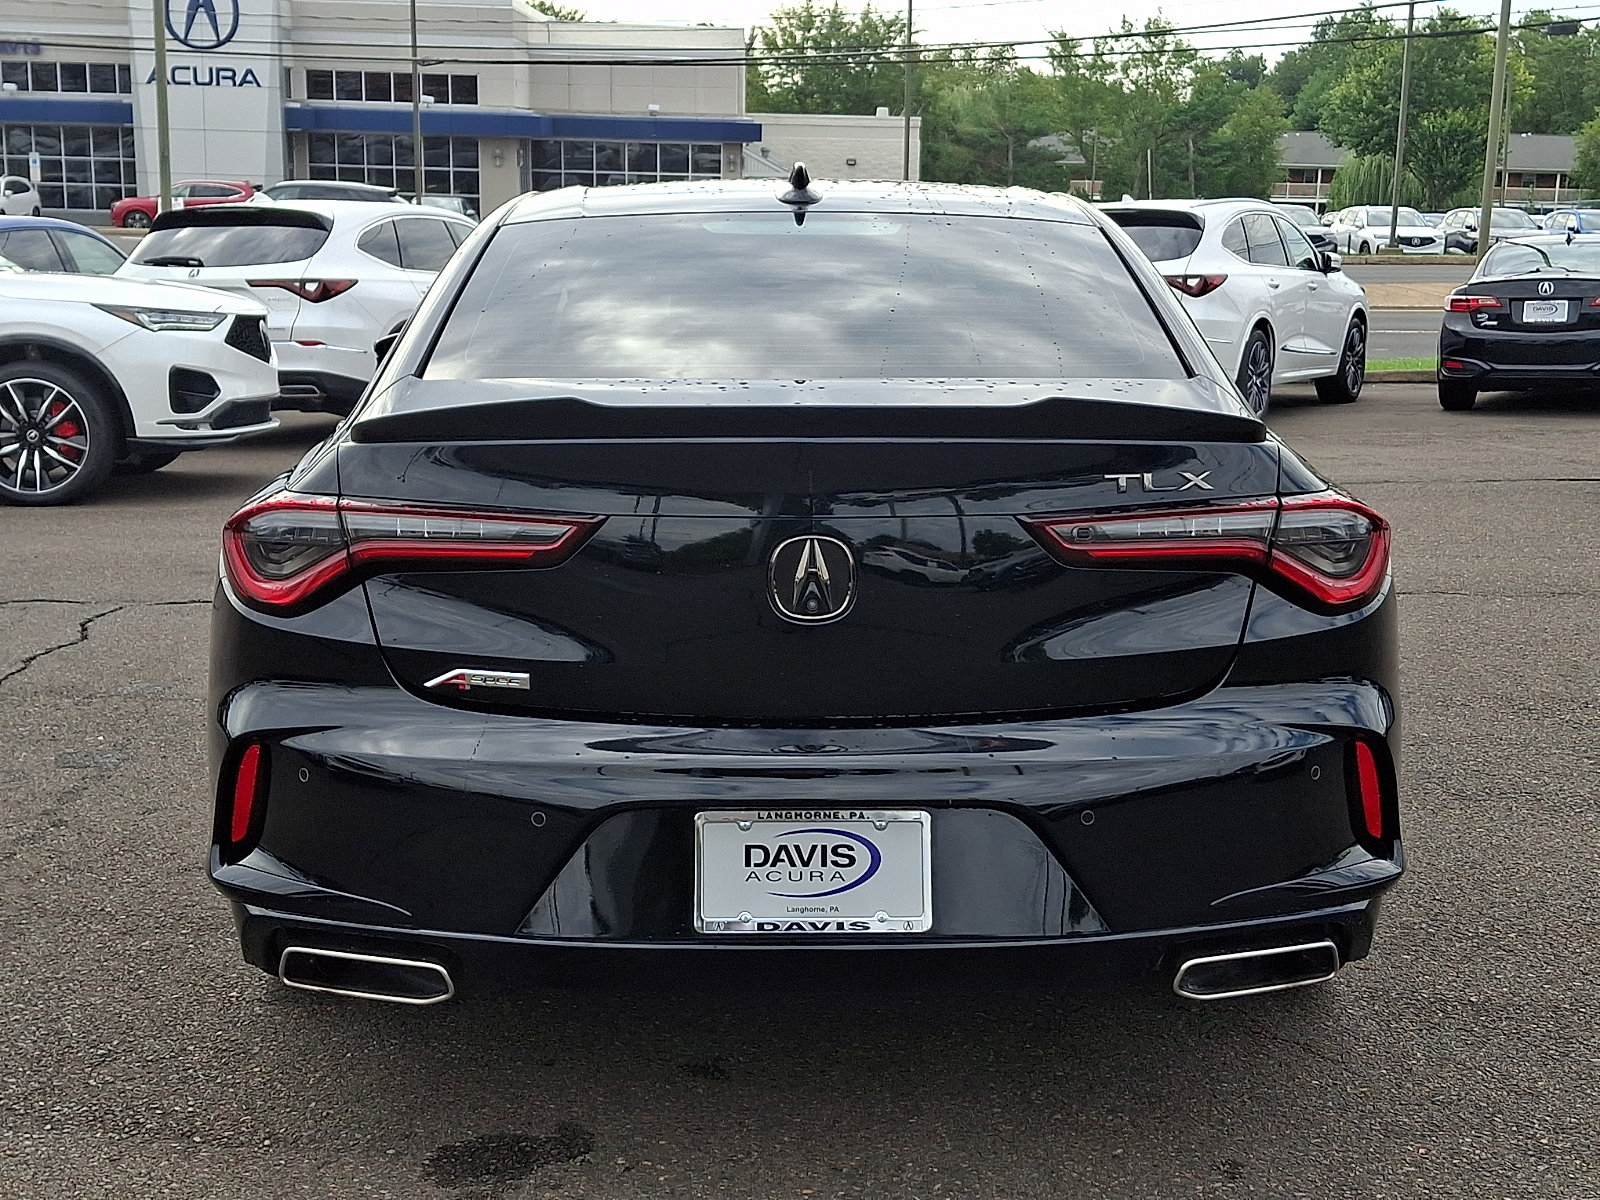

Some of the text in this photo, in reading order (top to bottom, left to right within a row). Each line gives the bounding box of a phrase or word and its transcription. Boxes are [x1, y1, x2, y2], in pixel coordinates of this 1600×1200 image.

[1103, 470, 1215, 493] TLX
[757, 811, 870, 820] LANGHORNE, PA.
[744, 844, 857, 868] DAVIS
[745, 870, 846, 882] ACURA
[786, 905, 840, 914] Langhorne, PA
[756, 921, 871, 932] DAVIS
